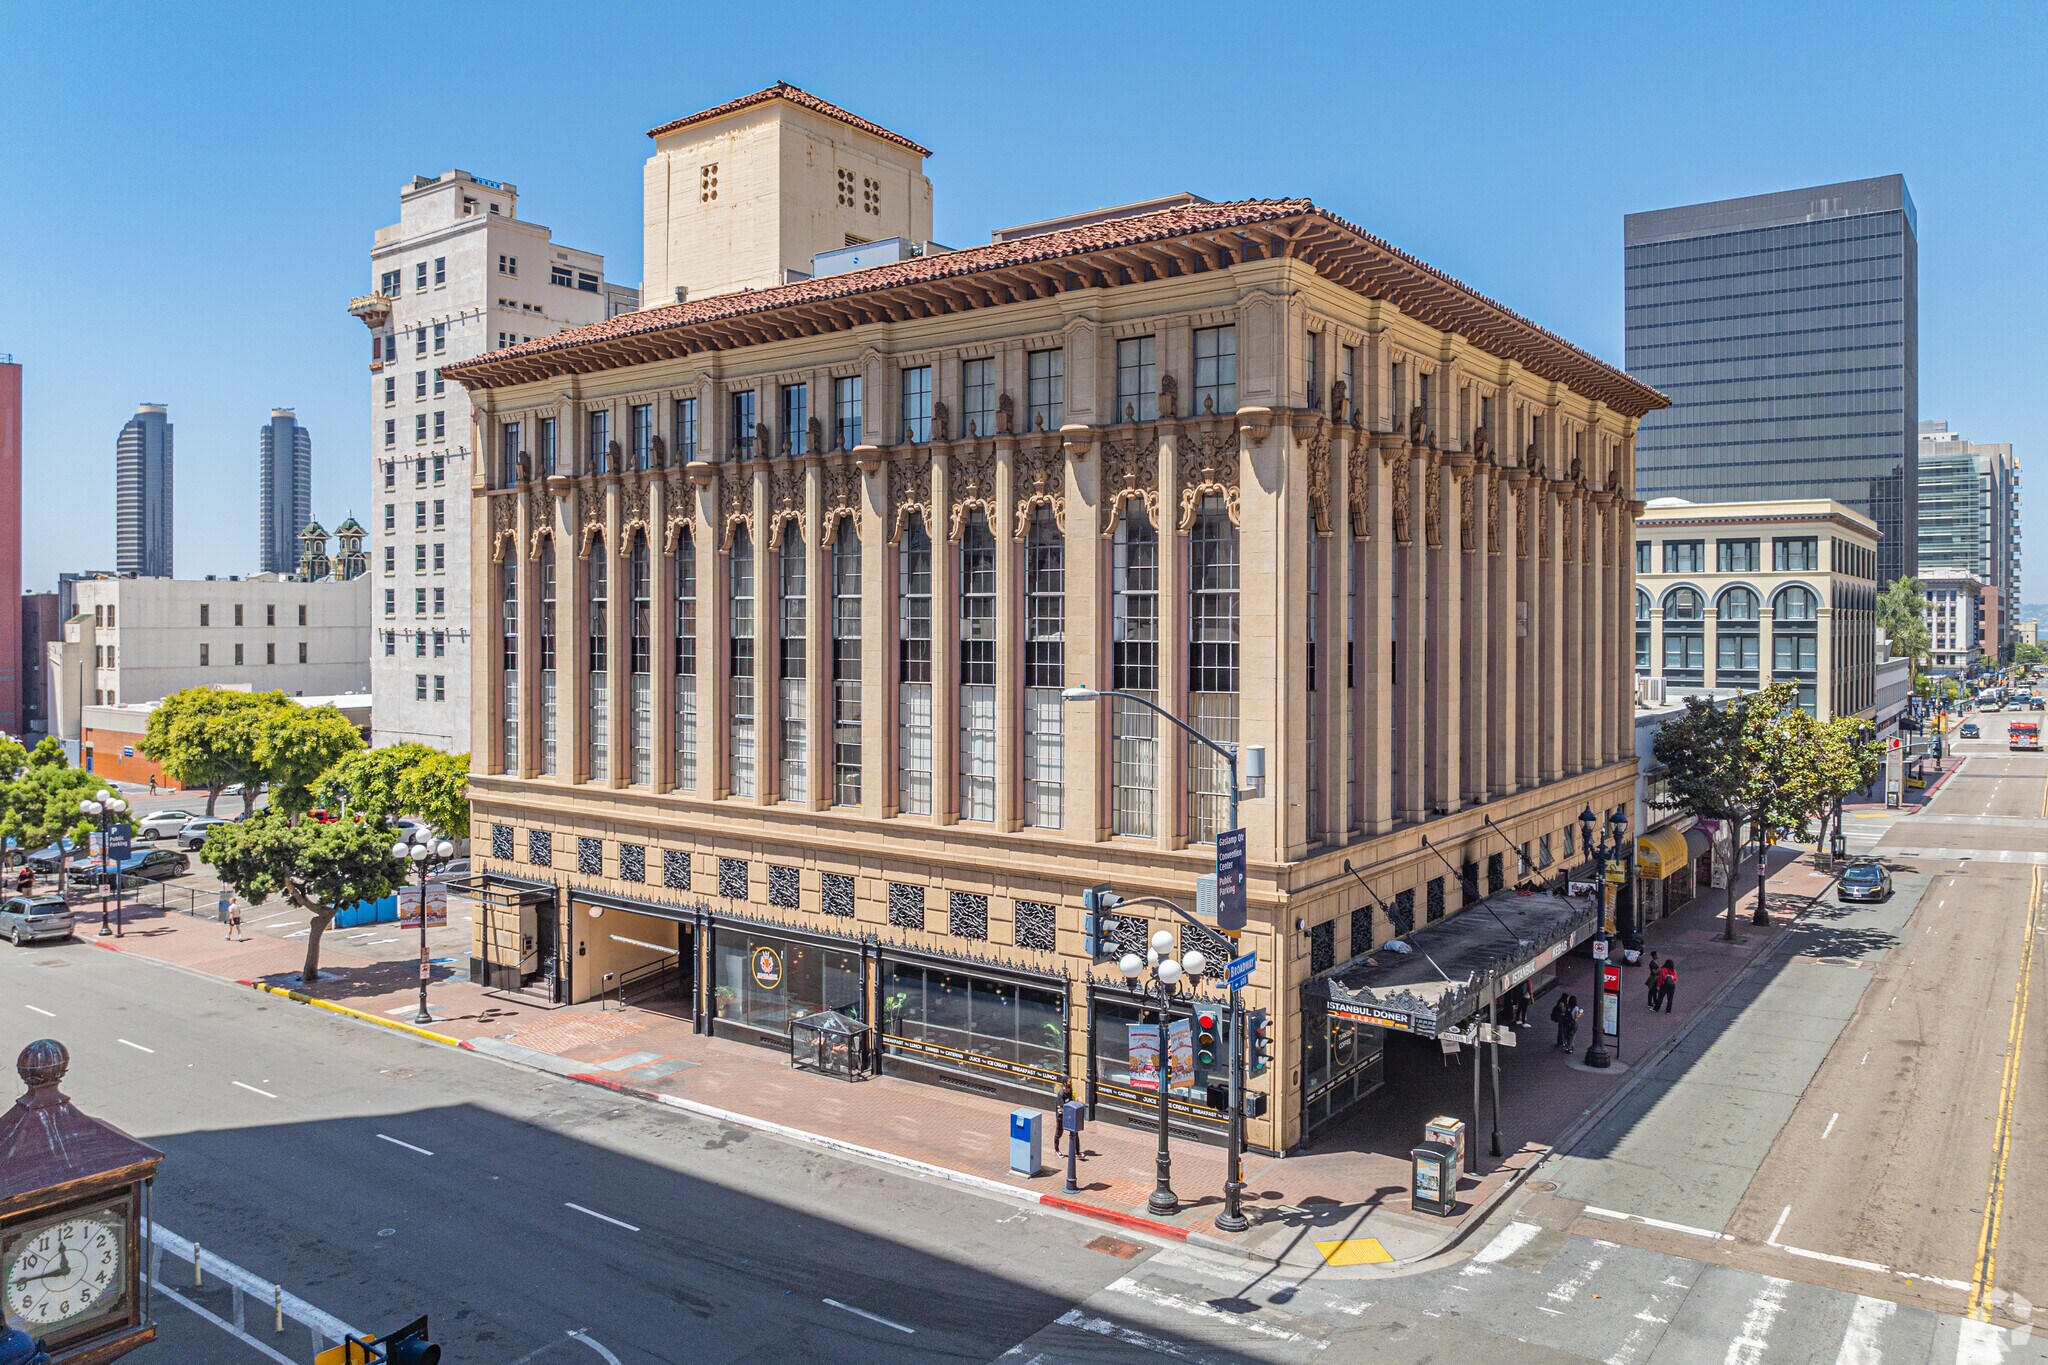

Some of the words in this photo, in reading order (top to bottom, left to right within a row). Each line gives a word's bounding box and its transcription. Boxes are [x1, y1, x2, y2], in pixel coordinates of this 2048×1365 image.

[1219, 836, 1237, 846] Gaslamp
[1219, 849, 1242, 861] Convention
[1219, 861, 1233, 871] Center
[1219, 875, 1233, 886] Public
[1238, 873, 1243, 883] P
[1219, 885, 1235, 896] Parking
[1552, 940, 1568, 956] KEBAB
[1230, 959, 1254, 978] BROADWAY
[1512, 961, 1536, 984] ISTANBUL
[1327, 1001, 1372, 1016] ISTANBUL
[1373, 1010, 1408, 1023] DONER
[1351, 1015, 1383, 1024] KEBAB
[1338, 1038, 1352, 1050] COFFEE
[882, 1036, 903, 1046] BREAKFAST
[925, 1046, 940, 1054] DINNER
[945, 1050, 964, 1058] CATERING
[1012, 1066, 1036, 1075] BREAKFAST
[1042, 1072, 1057, 1080] LUNCH
[1142, 1096, 1157, 1104] JUICE
[1172, 1103, 1189, 1112] CREAM
[1193, 1108, 1217, 1118] BREAKFAST
[57, 1225, 74, 1242] 12
[84, 1226, 88, 1240] 1
[39, 1236, 50, 1252] 11
[96, 1234, 107, 1249] 2
[22, 1254, 38, 1271] 10
[101, 1250, 112, 1265] 3
[95, 1270, 107, 1283] 4
[22, 1295, 32, 1308] 8
[80, 1288, 90, 1302] 5
[39, 1301, 49, 1317] 7
[60, 1300, 70, 1314] 6
